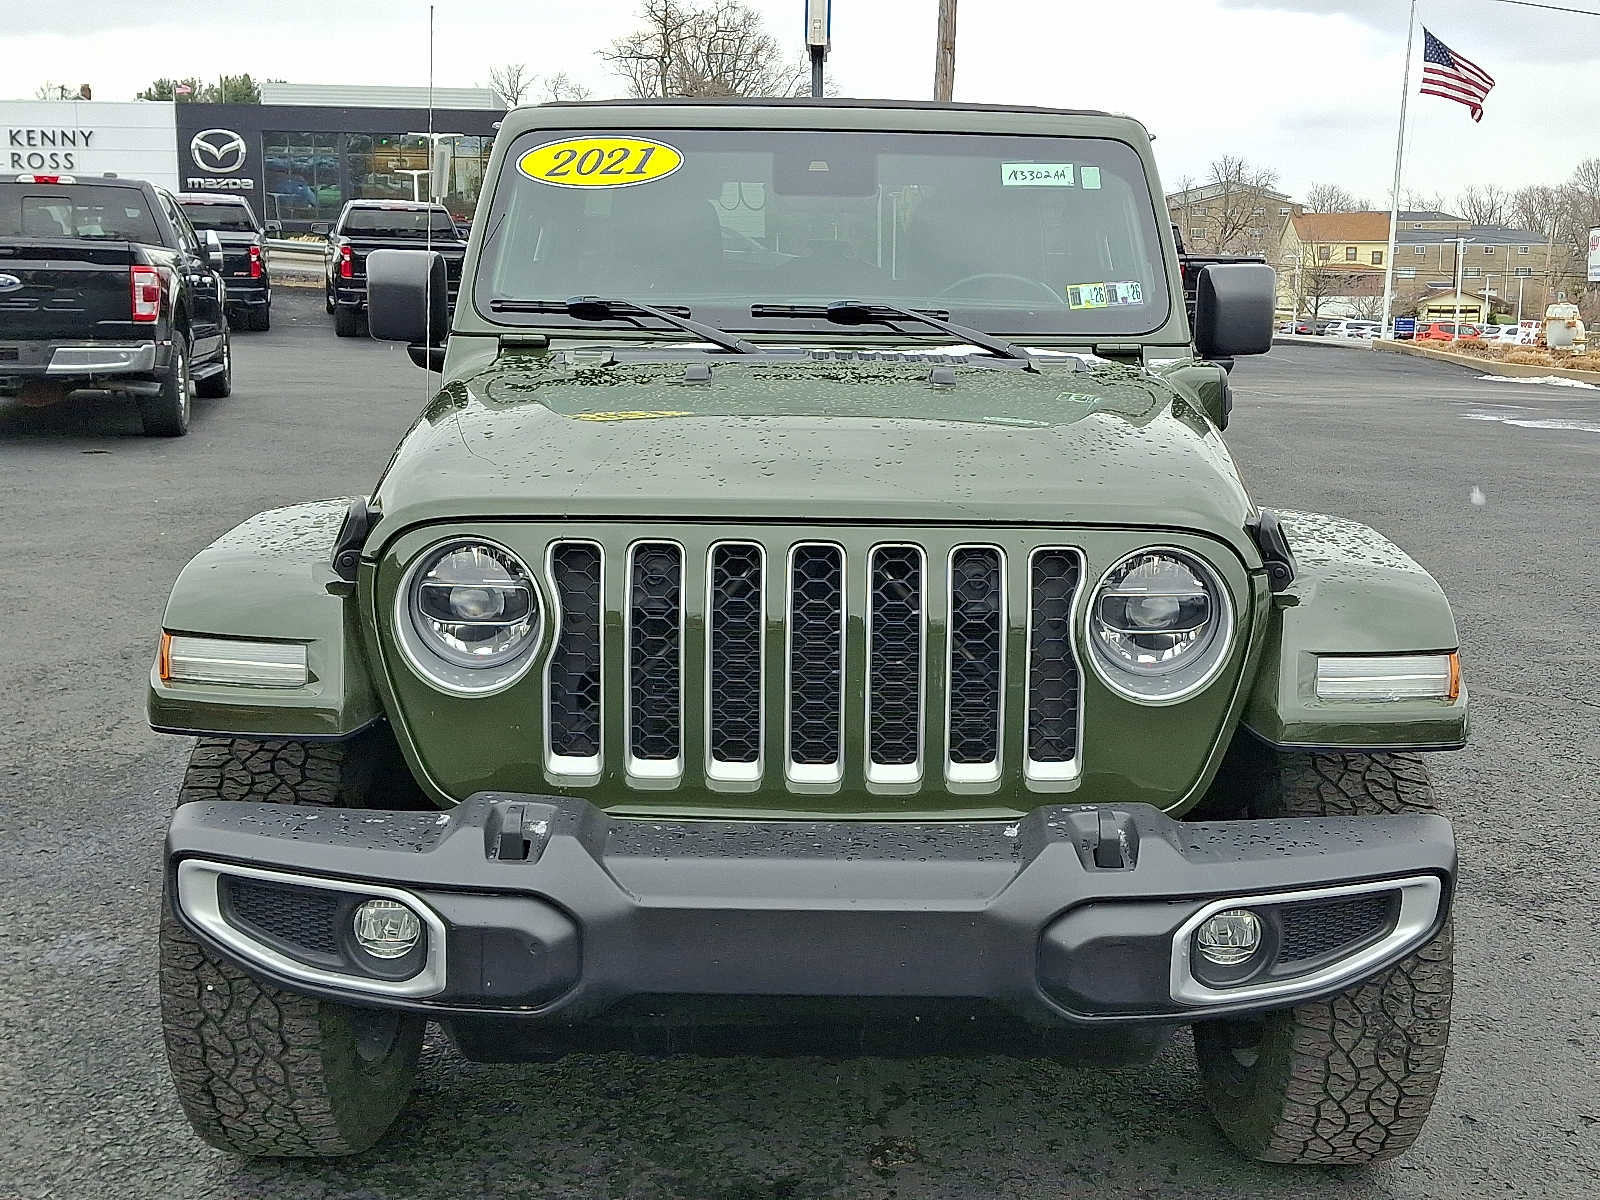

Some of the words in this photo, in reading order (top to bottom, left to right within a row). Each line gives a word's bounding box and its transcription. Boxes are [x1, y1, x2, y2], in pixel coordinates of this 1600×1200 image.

[9, 129, 93, 147] KENNY
[10, 152, 74, 170] ROSS
[545, 147, 655, 176] 2021
[186, 177, 254, 190] mazda
